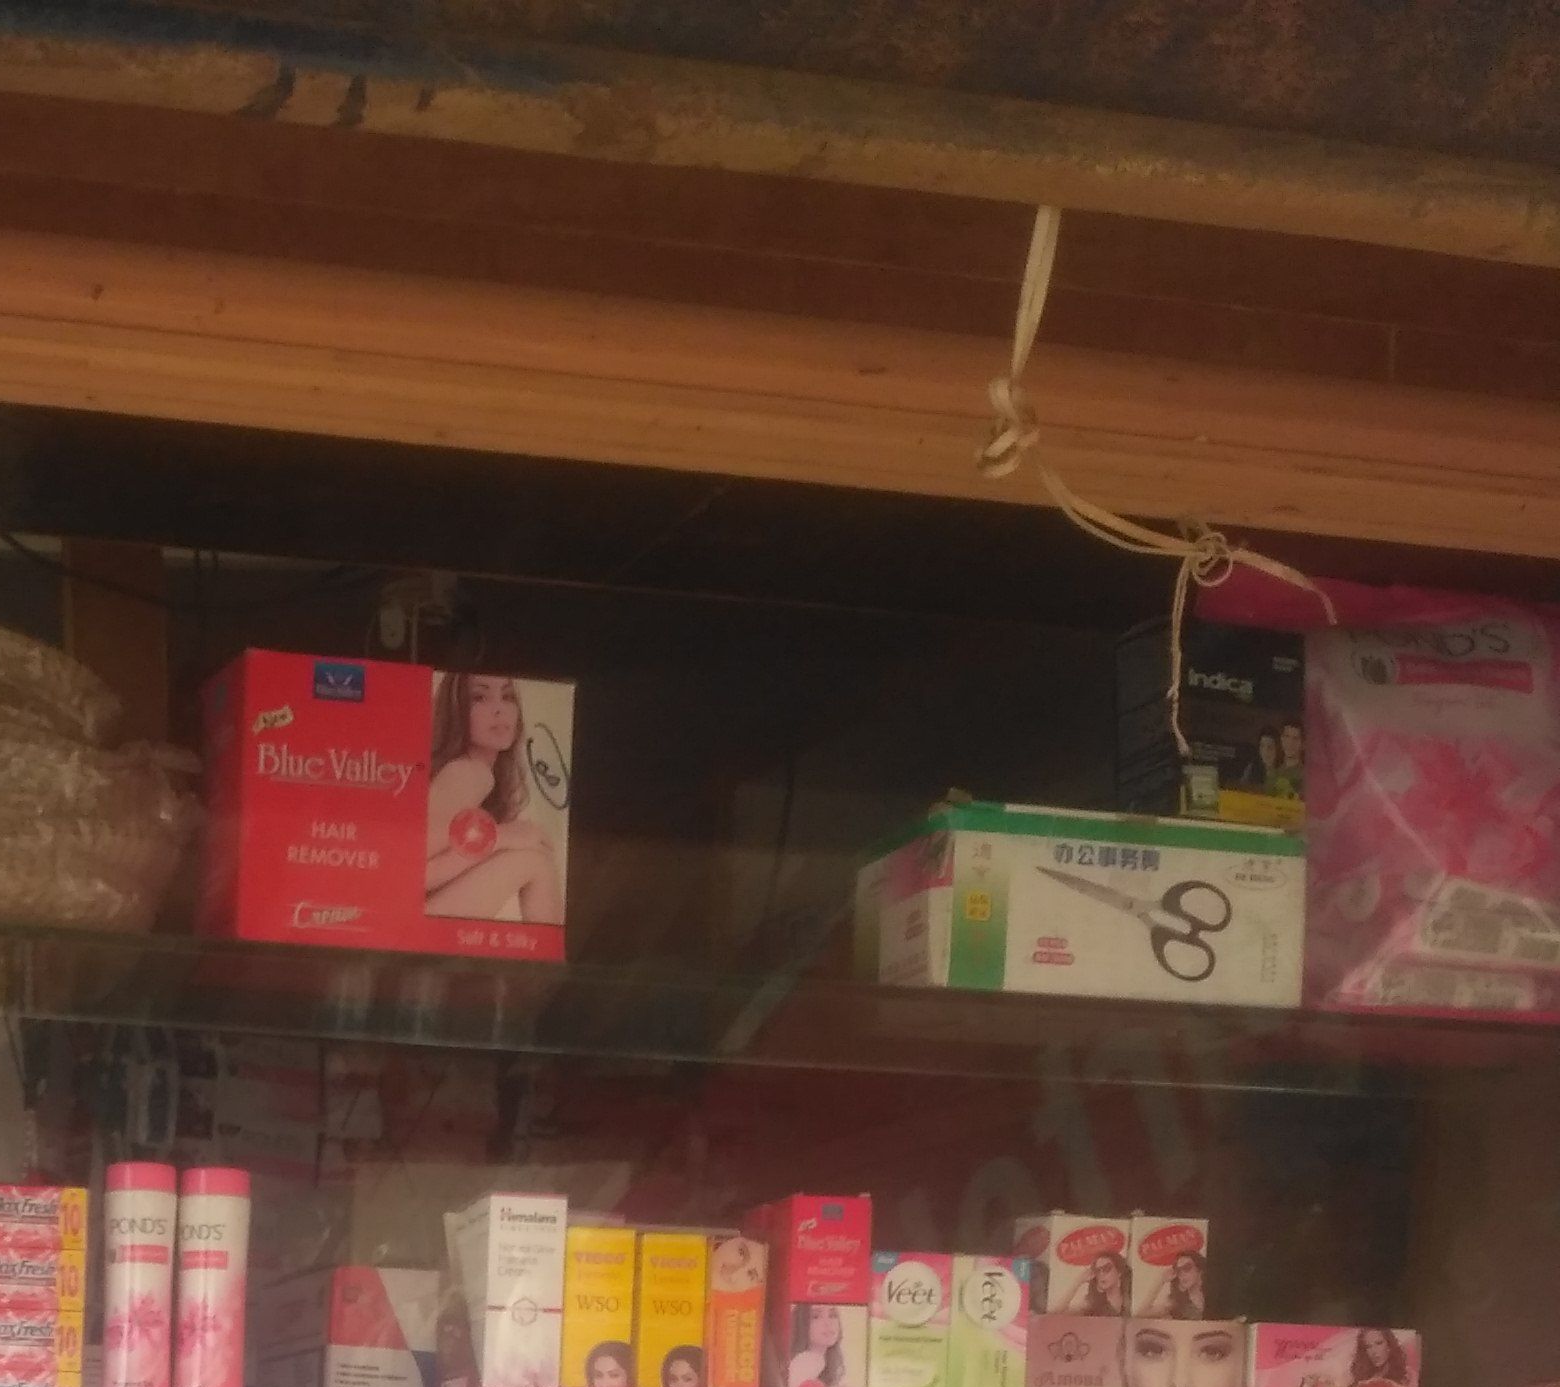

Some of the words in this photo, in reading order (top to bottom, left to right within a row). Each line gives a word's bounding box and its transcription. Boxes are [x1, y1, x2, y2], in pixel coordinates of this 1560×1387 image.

[1188, 669, 1254, 695] Indica
[255, 742, 324, 777] Blue
[329, 747, 415, 797] Valley
[311, 821, 358, 841] HAIR
[286, 846, 381, 870] REMOVER
[577, 1294, 621, 1313] WSO
[886, 1279, 937, 1306] Veet
[981, 1271, 1005, 1322] Veet
[652, 1299, 692, 1317] WSO
